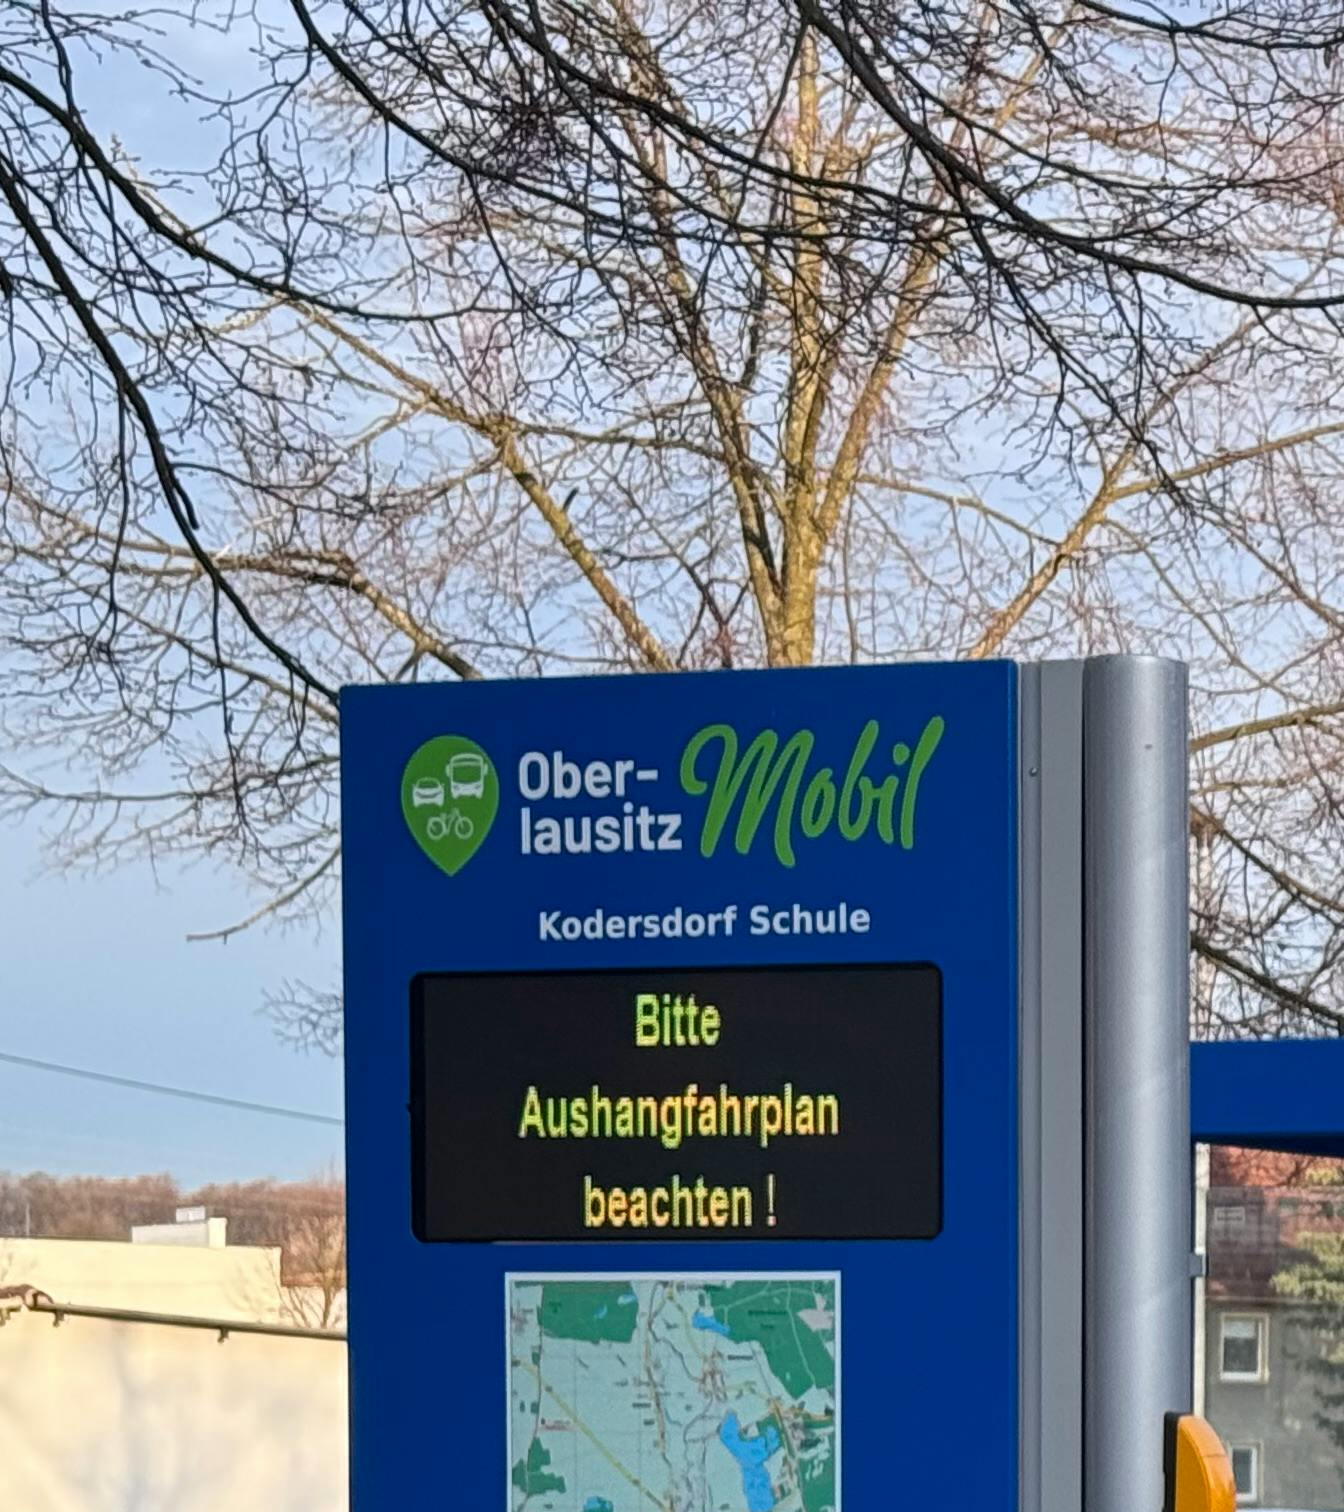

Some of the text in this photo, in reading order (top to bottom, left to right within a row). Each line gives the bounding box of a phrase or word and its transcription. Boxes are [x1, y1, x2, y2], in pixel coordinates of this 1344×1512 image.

[518, 751, 659, 800] Ober-
[680, 715, 945, 869] Mobil
[520, 801, 684, 854] lausitz
[539, 902, 872, 940] Kodersdorf Schule
[635, 993, 722, 1047] Bitte
[518, 1082, 840, 1149] Aushangfahrplan
[583, 1174, 753, 1228] beachten
